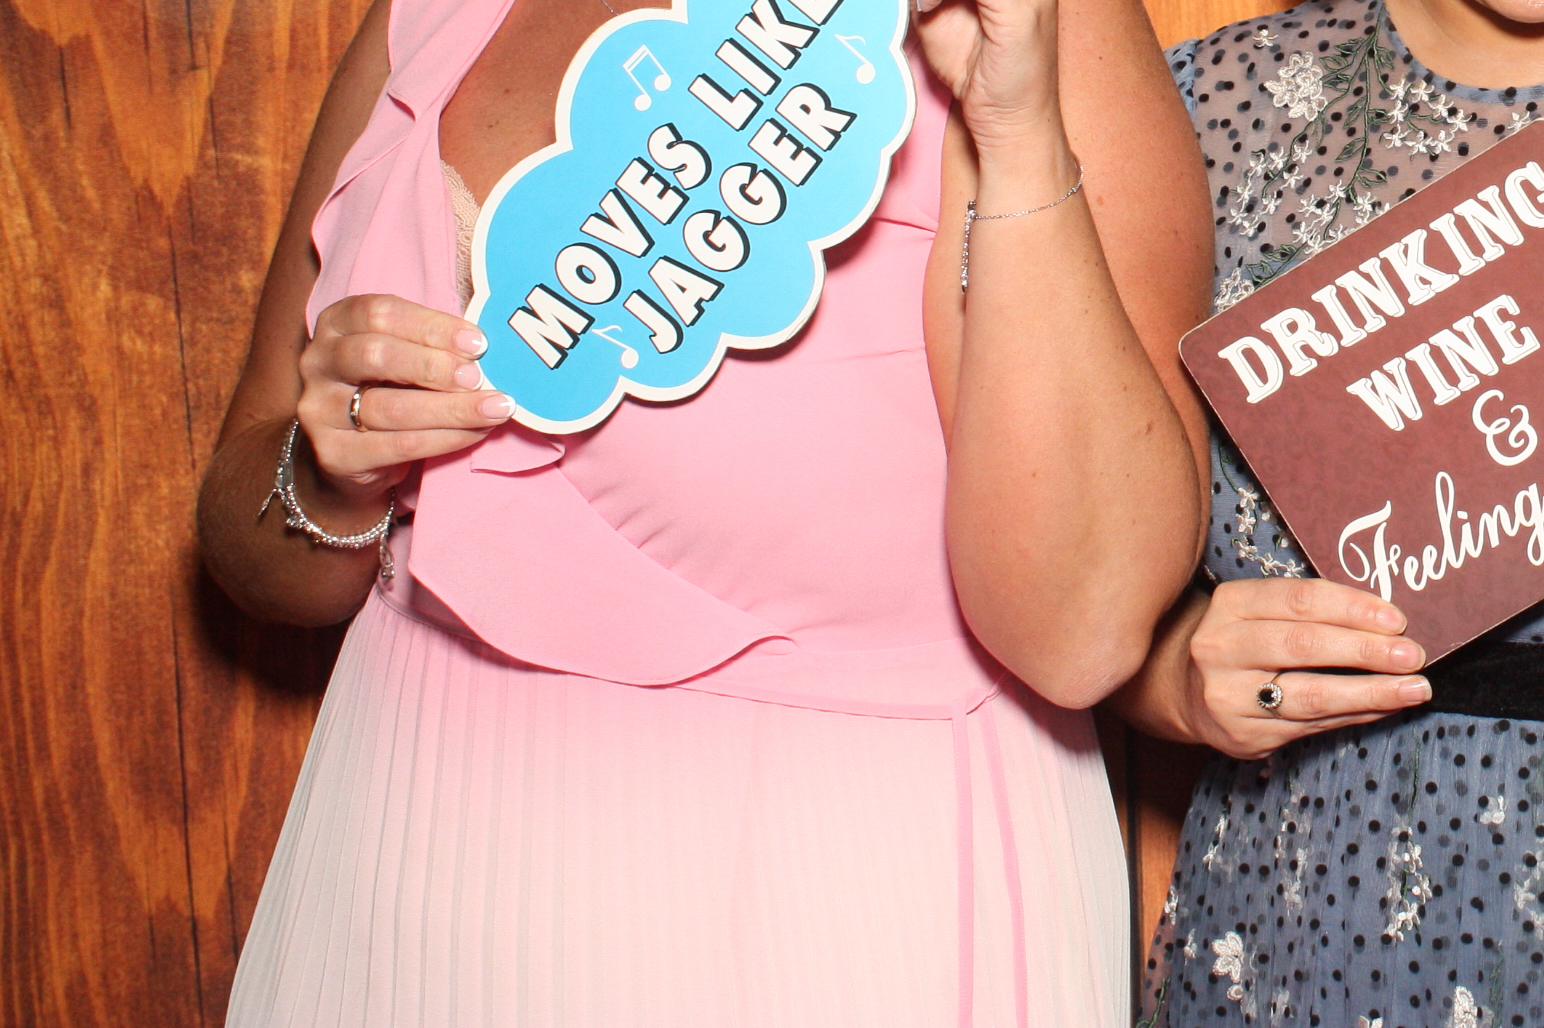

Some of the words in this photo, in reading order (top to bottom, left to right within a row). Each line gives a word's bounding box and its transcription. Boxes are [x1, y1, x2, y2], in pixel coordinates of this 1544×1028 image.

[507, 122, 712, 370] MOVES
[622, 82, 857, 354] JAGGER
[1346, 294, 1541, 432] WINE
[1471, 389, 1538, 466] &
